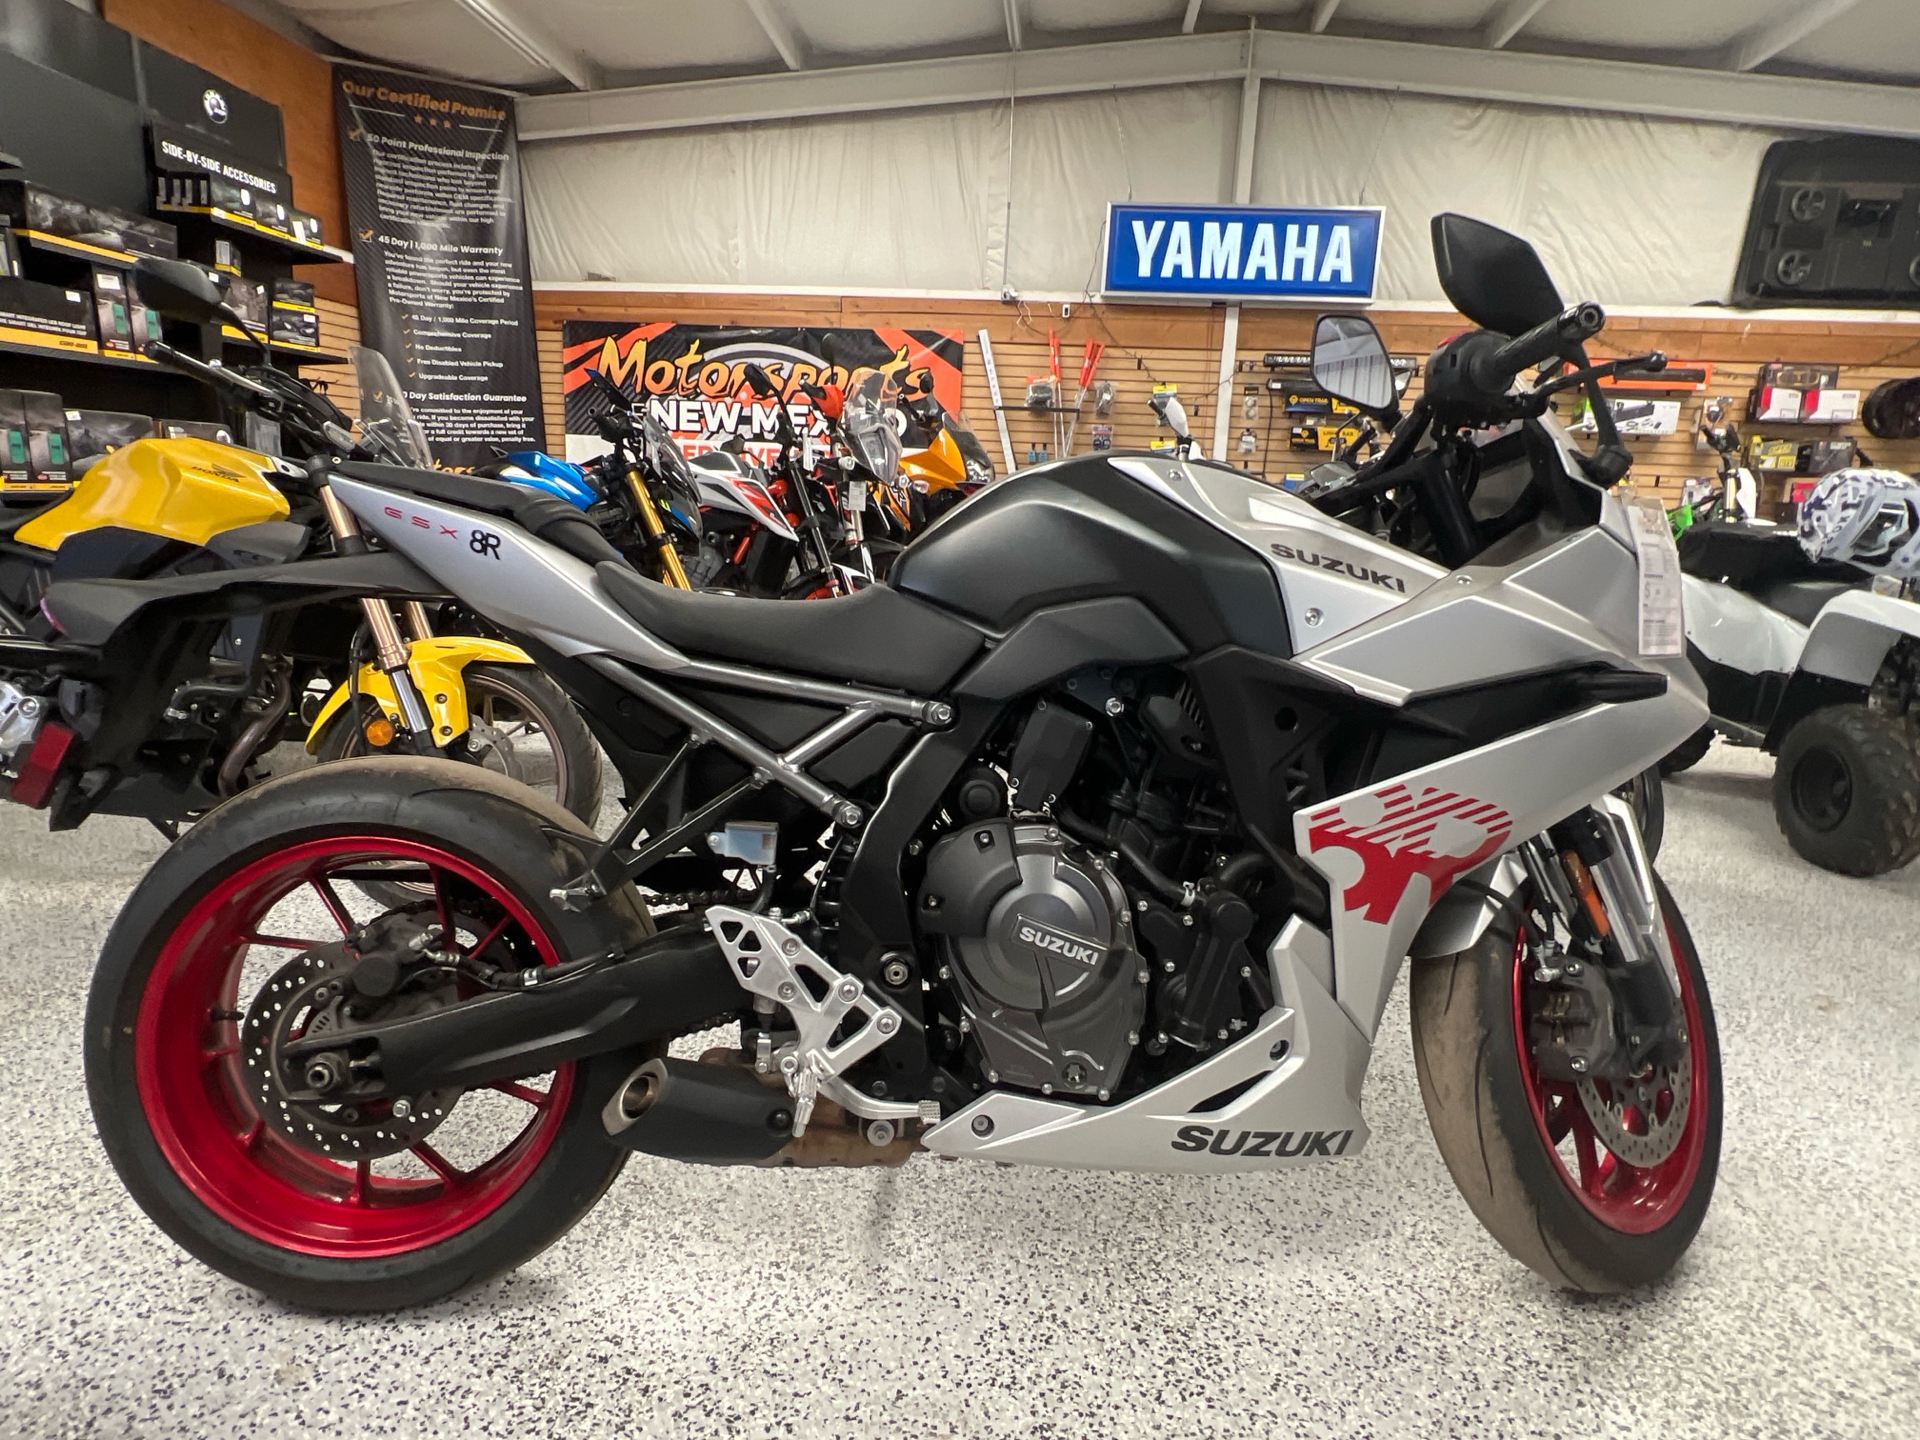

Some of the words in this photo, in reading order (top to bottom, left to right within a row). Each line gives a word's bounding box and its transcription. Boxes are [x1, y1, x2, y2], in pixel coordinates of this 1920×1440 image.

[342, 80, 374, 98] Our
[377, 87, 450, 113] Certified
[451, 103, 507, 121] Promise
[366, 133, 380, 143] 50
[381, 136, 407, 149] Point
[408, 142, 464, 158] Professional
[465, 150, 509, 161] Inspection
[161, 140, 221, 174] SIDE-BY-SIDE
[223, 163, 277, 194] ACCESSORIES
[379, 235, 390, 244] 45
[391, 237, 409, 250] Day
[415, 241, 438, 251] 1,000
[440, 244, 459, 252] Mile
[460, 246, 503, 257] Warranty
[1131, 220, 1353, 283] YAMAHA
[389, 289, 425, 300] Motorsports
[491, 283, 523, 291] experience
[503, 290, 510, 298] by
[389, 297, 423, 306] Pre-Owned
[420, 315, 432, 323] Day
[470, 318, 499, 326] Coverage
[500, 319, 519, 327] Period
[413, 329, 461, 338] Comprehensive
[462, 331, 491, 340] Coverage
[425, 344, 462, 352] Deductibles
[459, 374, 489, 382] Coverage
[597, 336, 931, 402] Motorsports
[409, 392, 427, 401] Day
[428, 392, 481, 401] Satisfaction
[483, 394, 528, 402] Guarantee
[473, 407, 503, 415] enjoyment
[650, 399, 739, 433] NEW
[191, 466, 240, 484] HONDA
[384, 506, 458, 540] GSX
[469, 529, 502, 561] 8R
[1270, 543, 1406, 593] SUZUKI
[1019, 926, 1099, 966] SUZUKI
[1171, 1125, 1354, 1157] SUZUKI
